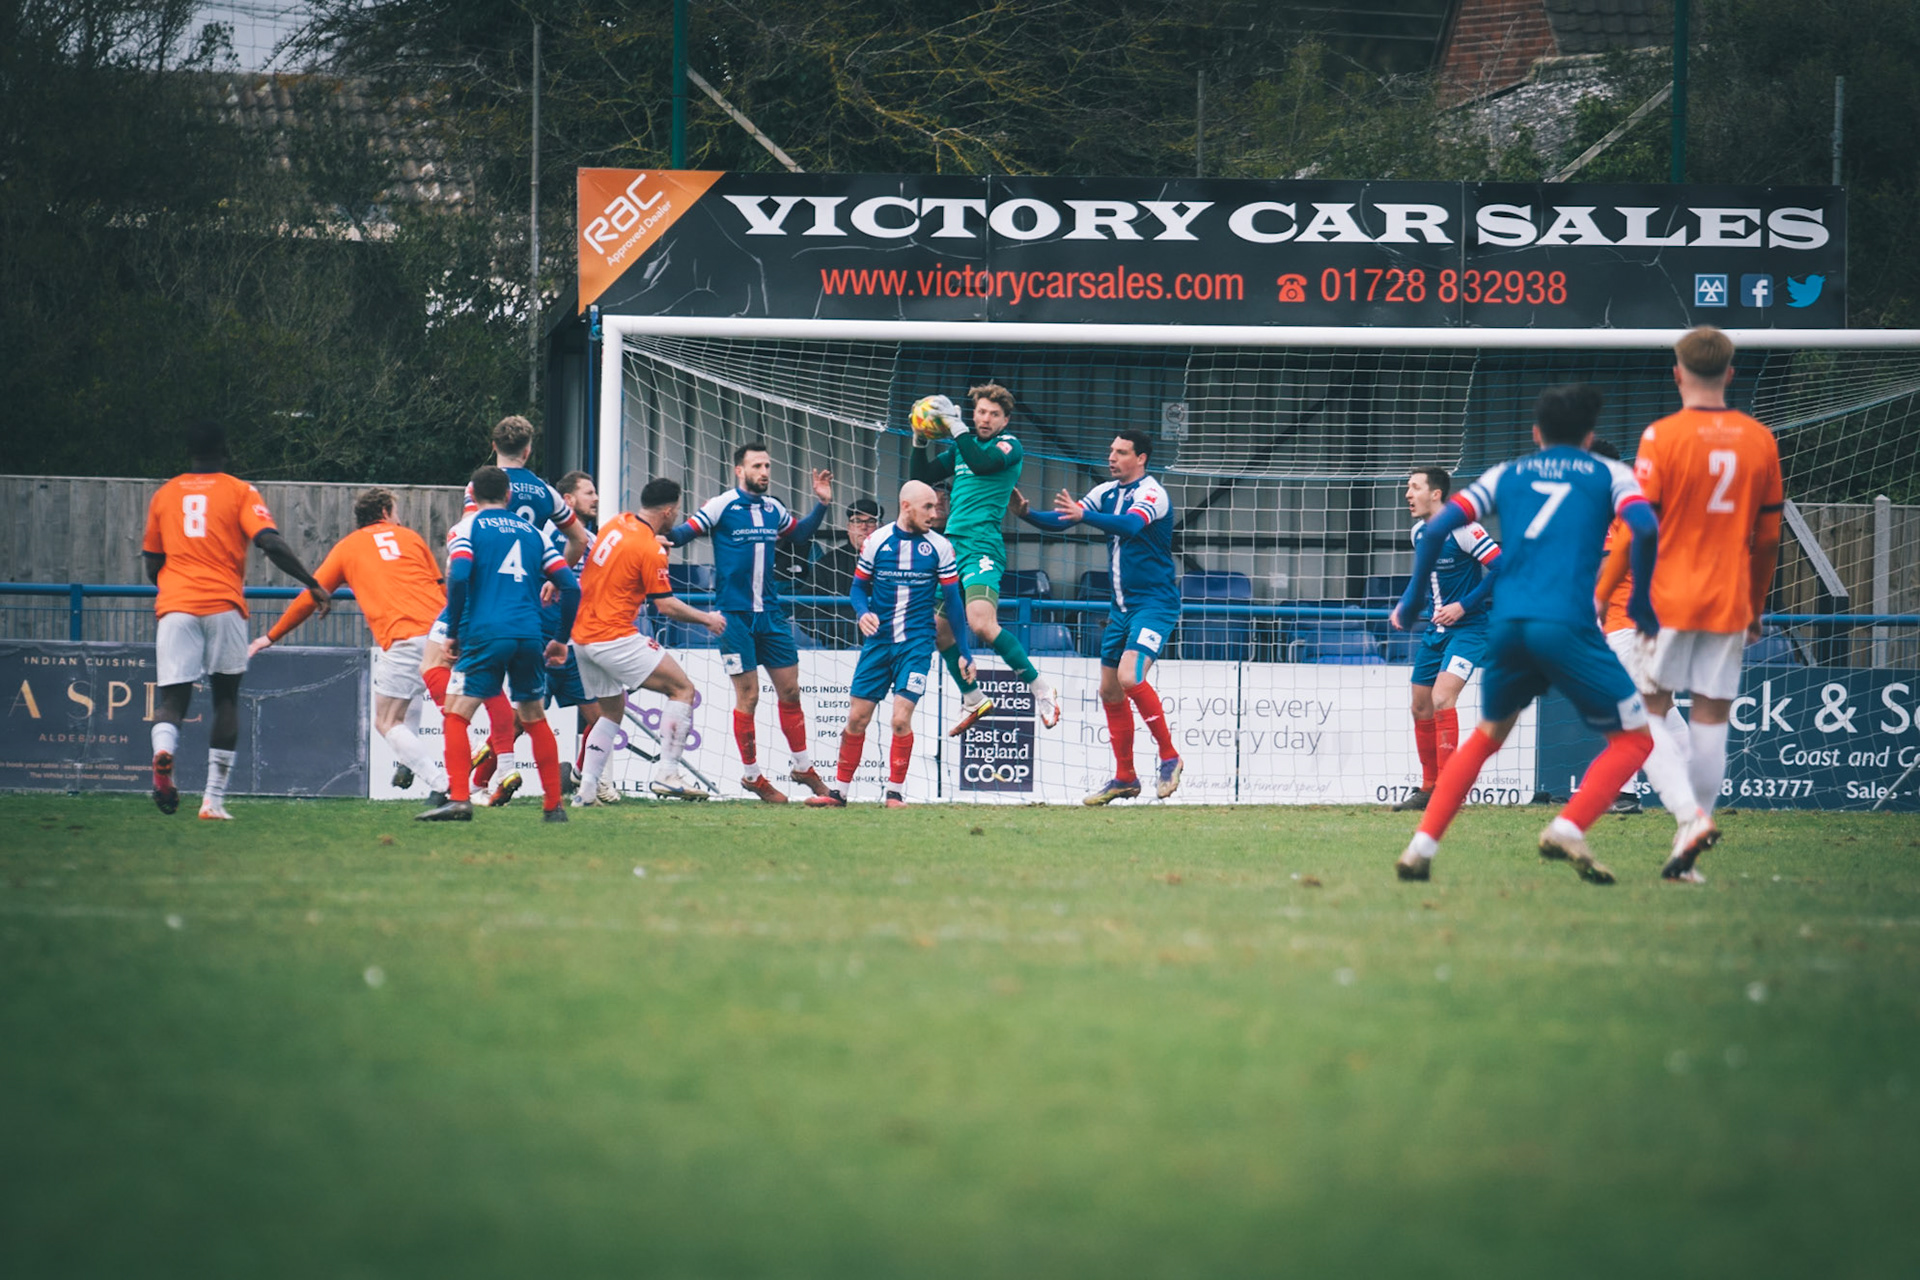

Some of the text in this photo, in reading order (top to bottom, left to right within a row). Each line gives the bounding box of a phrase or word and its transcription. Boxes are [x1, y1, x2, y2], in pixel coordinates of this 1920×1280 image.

[723, 195, 1829, 249] VICTORY CAR SALES
[606, 200, 672, 266] Approved Dealer
[820, 263, 1567, 305] www.victorycarsales.com 01728 832938
[510, 482, 546, 498] ISHERS
[1707, 450, 1737, 513] 2
[182, 494, 207, 538] 8
[1525, 480, 1572, 539] 7
[477, 517, 533, 533] FISHERS
[373, 531, 402, 561] 5
[593, 529, 623, 567] 6
[497, 539, 528, 582] 4
[24, 656, 146, 668] INDIAN CUISINE
[762, 685, 818, 693] EANDS
[976, 681, 1031, 694] uneral
[818, 700, 850, 708] LEISTO
[989, 694, 1031, 709] vices
[1162, 696, 1187, 714] or
[1197, 697, 1247, 721] you
[1256, 699, 1333, 725] every
[1814, 683, 1858, 733] &
[1880, 682, 1920, 734] S
[39, 733, 129, 744] ALDEBURGH
[964, 728, 1020, 743] East of
[1185, 728, 1265, 754] every
[1274, 725, 1322, 755] day
[964, 744, 1029, 763] England
[1779, 744, 1840, 767] Coast
[1848, 745, 1890, 768] and
[964, 764, 1029, 783] COOP
[1487, 776, 1521, 785] Leiston
[1469, 787, 1520, 804] 0670
[1740, 778, 1814, 797] 633777
